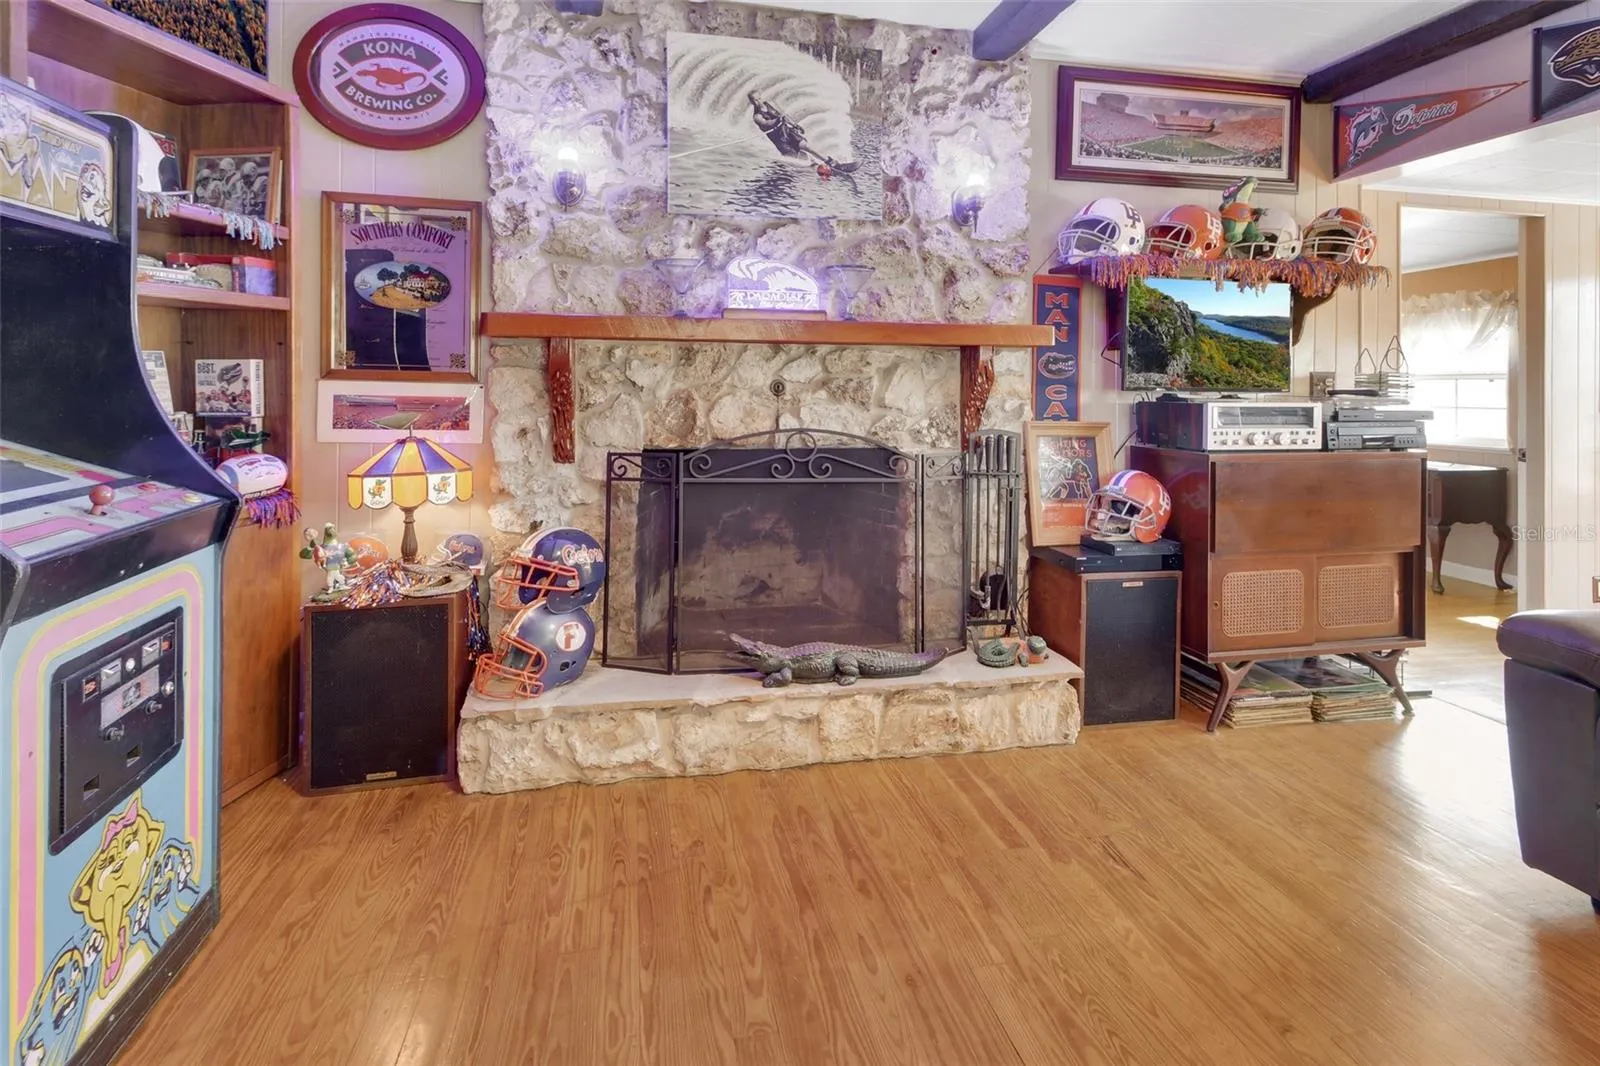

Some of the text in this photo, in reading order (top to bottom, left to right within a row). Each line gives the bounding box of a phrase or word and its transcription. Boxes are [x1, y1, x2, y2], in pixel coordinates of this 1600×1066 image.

[363, 40, 417, 60] KONA
[345, 85, 414, 111] BREWING
[351, 221, 404, 245] SOUTHERN
[406, 221, 456, 250] COMFORT
[1043, 384, 1069, 420] CA
